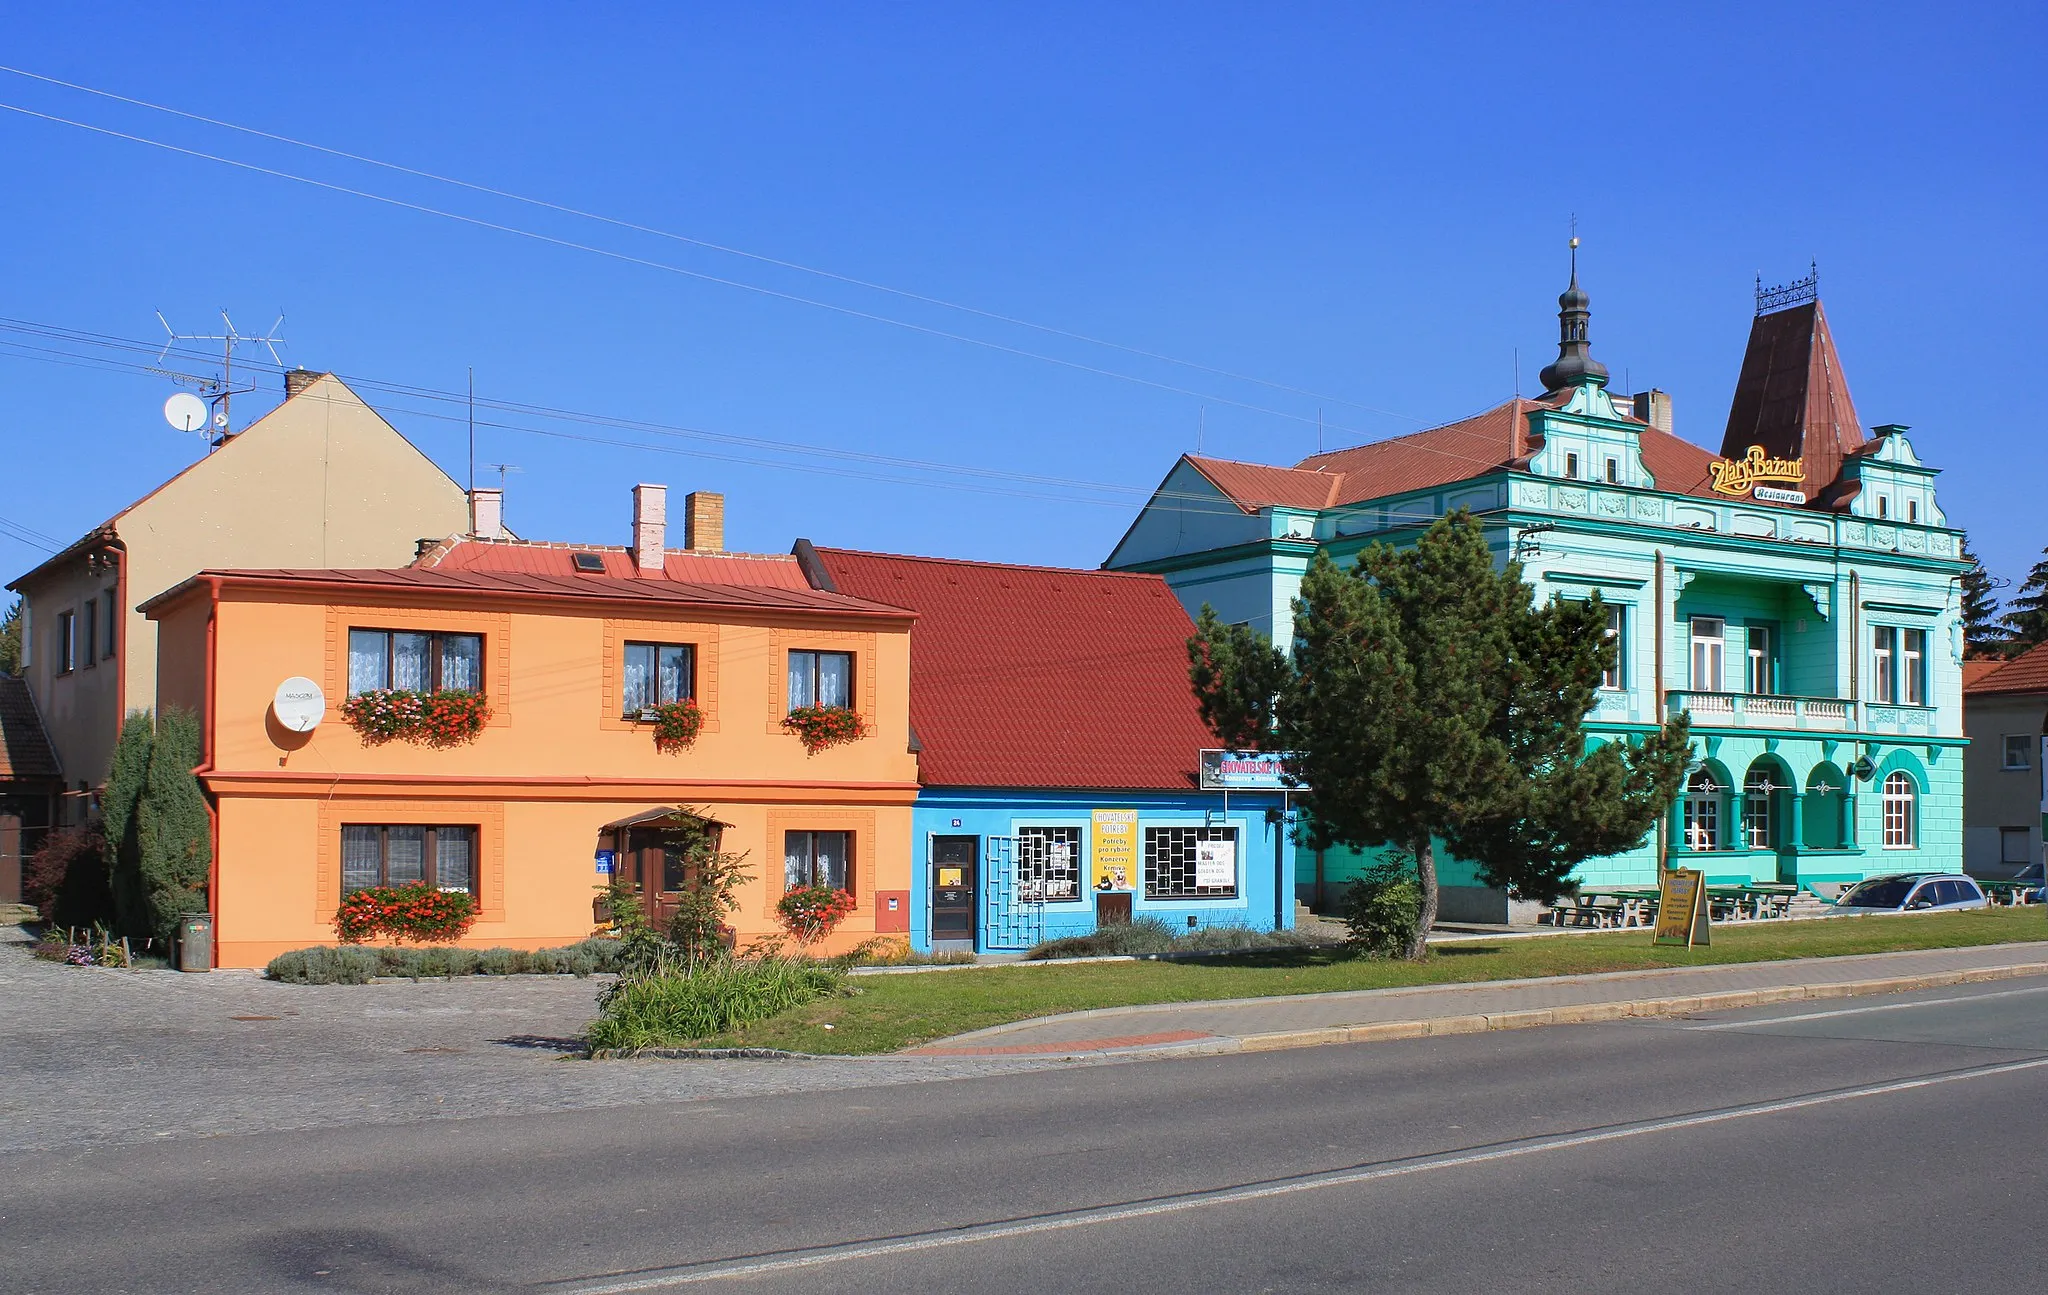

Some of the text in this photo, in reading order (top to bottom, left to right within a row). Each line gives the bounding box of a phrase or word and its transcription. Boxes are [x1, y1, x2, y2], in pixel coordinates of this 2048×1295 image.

[1710, 445, 1805, 496] Zlatý Bažant
[1757, 488, 1804, 503] Restaurant
[1225, 774, 1276, 784] Konzervy Krmiva
